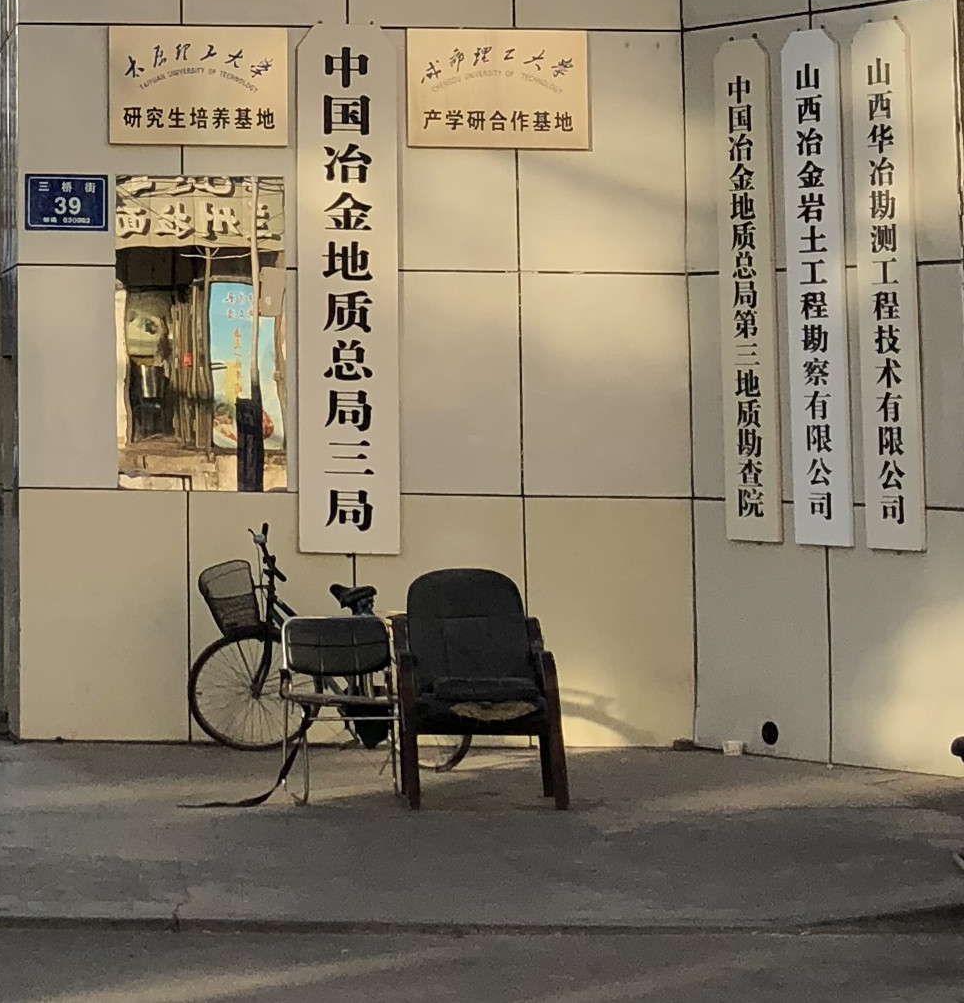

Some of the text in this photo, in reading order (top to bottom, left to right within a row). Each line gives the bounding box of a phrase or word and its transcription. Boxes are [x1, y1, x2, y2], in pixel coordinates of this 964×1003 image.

[124, 43, 274, 78] 太原理工大学
[421, 46, 574, 84] 成都理工大学
[139, 67, 259, 93] TAIYUAN UNIVERSITY OF TECHNOLOGY
[463, 69, 502, 80] UNIVERSITY
[505, 70, 515, 78] OF
[521, 73, 563, 94] TECHNOLOGY
[123, 106, 276, 130] 研究生培养基地
[423, 109, 574, 132] 产学研合作基地
[54, 196, 81, 215] 39
[322, 46, 374, 532] 中国冶金地质总局三局
[727, 75, 764, 518] 中国冶金地质总局第三地质勘查院
[795, 63, 833, 521] 山西冶金岩土工程勘察有限公司
[867, 58, 906, 525] 山西华冶勘测工程技术有限公司
